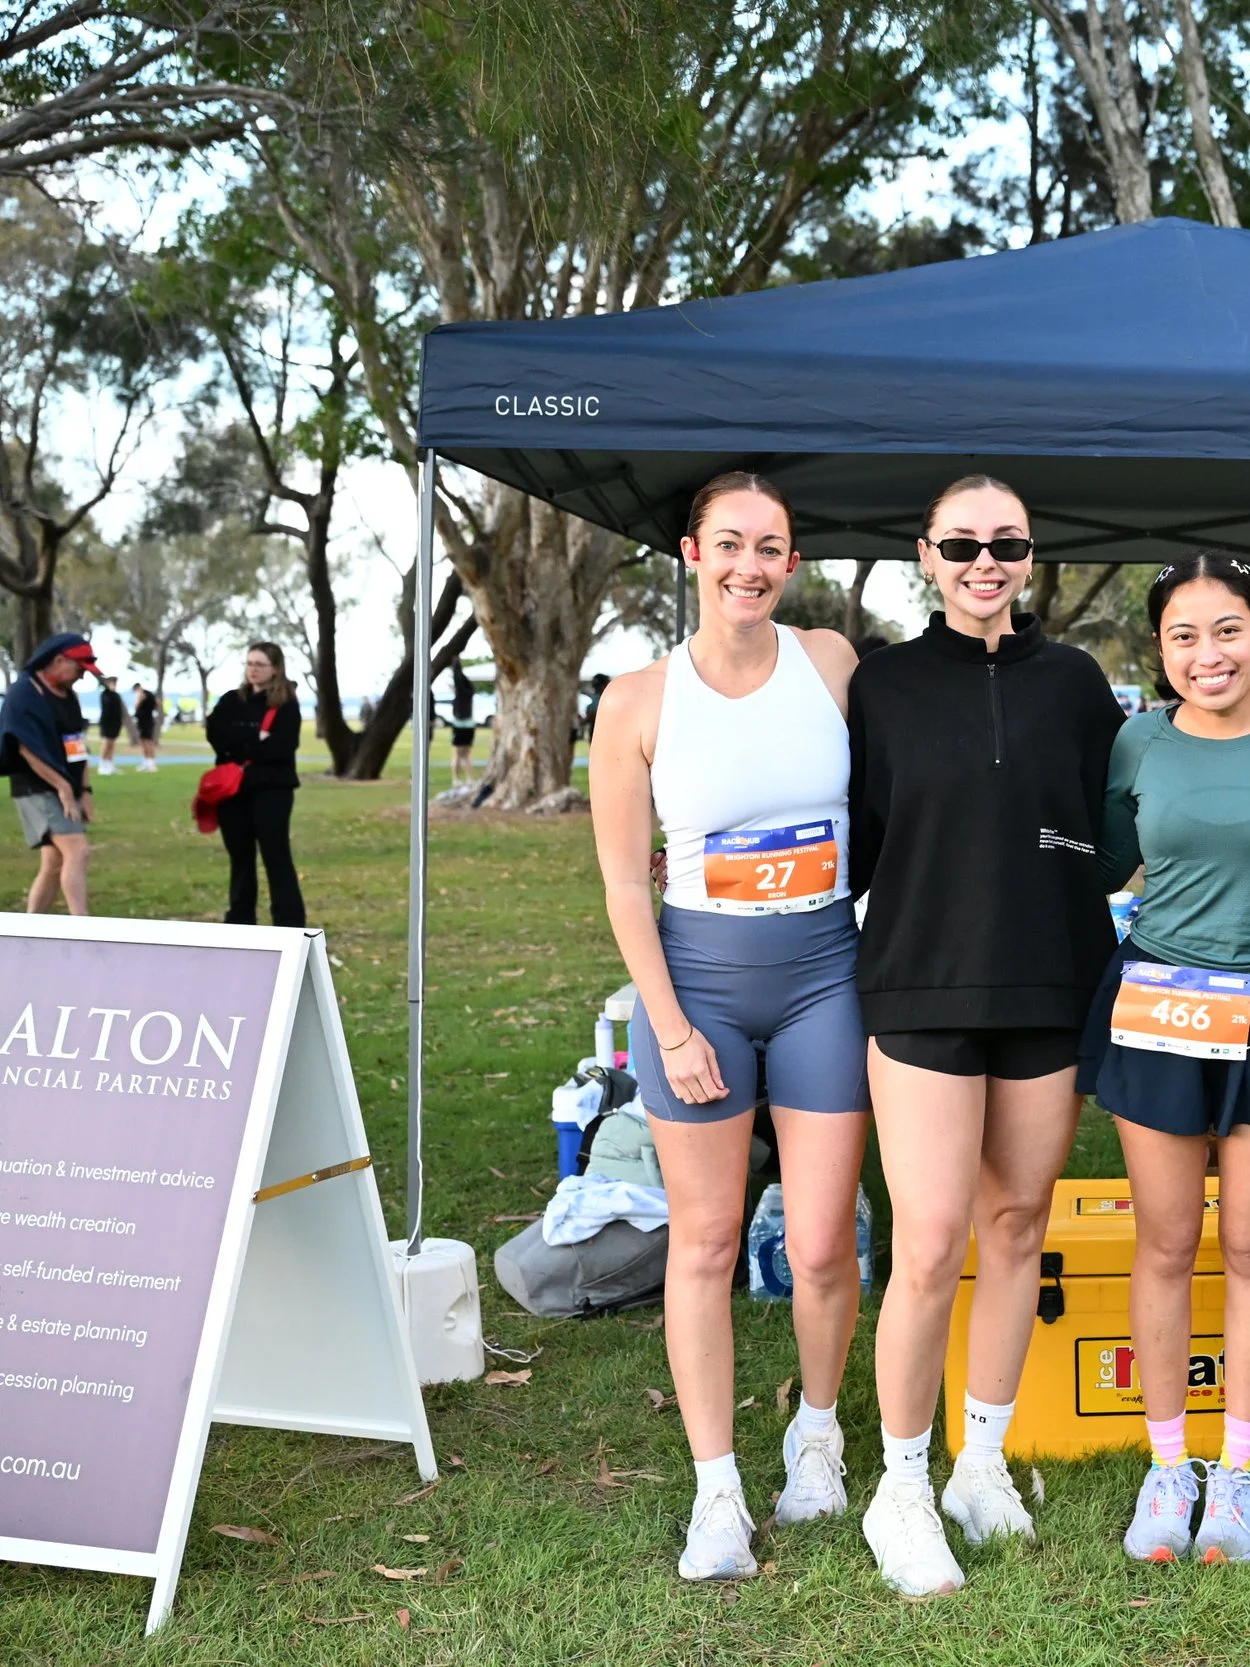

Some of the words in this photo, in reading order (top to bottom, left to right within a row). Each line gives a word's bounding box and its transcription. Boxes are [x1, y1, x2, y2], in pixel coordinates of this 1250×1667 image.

[495, 395, 600, 417] CLASSIC
[762, 850, 792, 859] RUNNING
[793, 846, 819, 855] FESTIVAL
[755, 860, 796, 890] 27
[1151, 999, 1211, 1031] 466
[0, 1002, 247, 1071] ALTON
[1, 1066, 83, 1090] NCIAL
[95, 1071, 233, 1100] PARTNERS
[56, 1160, 66, 1177] &
[70, 1162, 157, 1184] investment
[159, 1169, 215, 1189] advice
[15, 1210, 66, 1229] wealth
[70, 1216, 136, 1235] creation
[3, 1259, 95, 1284] self-funded
[96, 1270, 182, 1292] retirement
[7, 1313, 17, 1331] &
[21, 1317, 72, 1336] estate
[73, 1320, 148, 1348] planning
[1095, 1349, 1115, 1389] ice
[60, 1375, 135, 1403] planning
[0, 1455, 81, 1481] com.au
